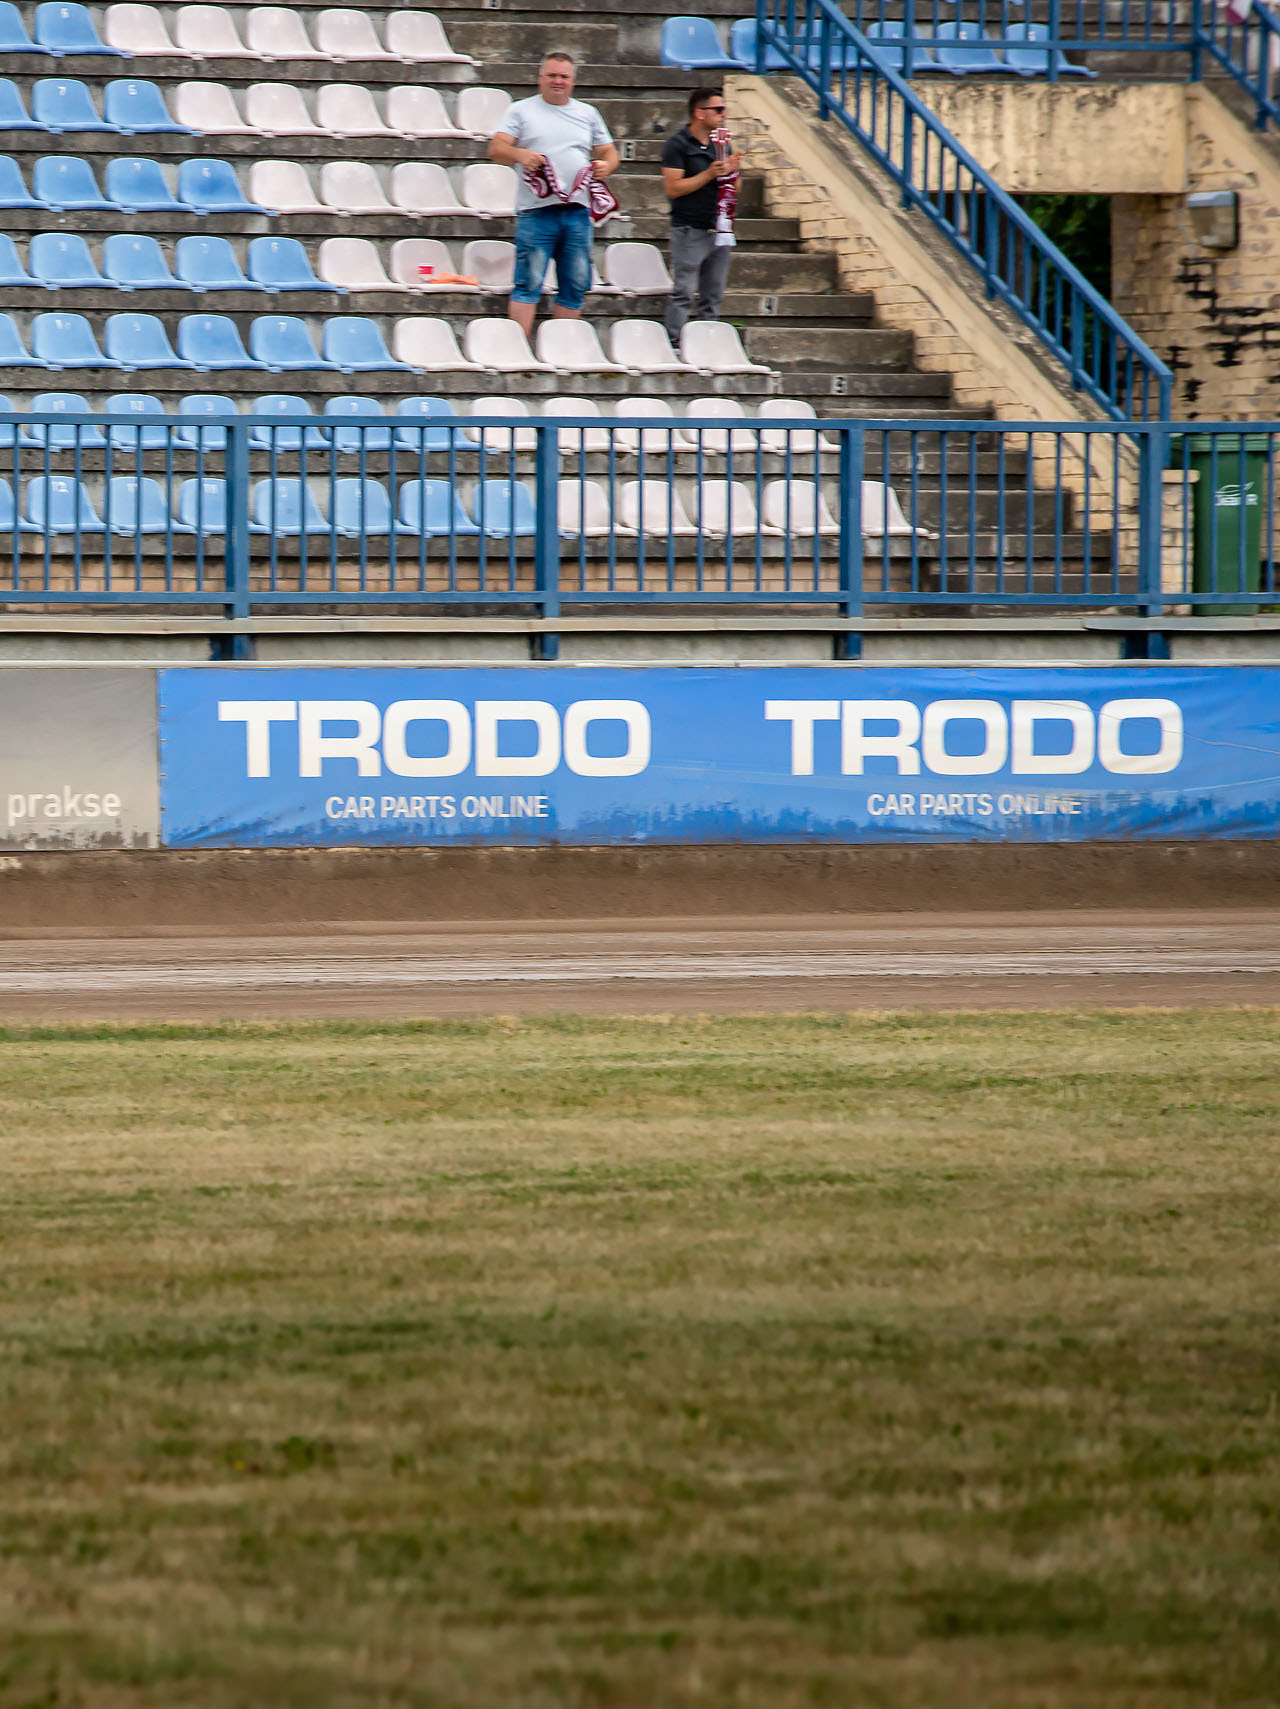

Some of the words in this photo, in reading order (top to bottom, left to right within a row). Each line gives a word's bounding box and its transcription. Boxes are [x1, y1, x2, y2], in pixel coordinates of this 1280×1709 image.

[58, 86, 67, 96] 7
[218, 699, 651, 777] TRODO
[764, 698, 1184, 776] TRODO
[8, 785, 121, 826] prakse
[325, 796, 375, 819] CAR
[380, 796, 456, 819] PARTS
[461, 795, 549, 818] ONLINE
[867, 794, 916, 816] CAR
[920, 794, 992, 816] PARTS
[997, 793, 1082, 815] ONLINE
